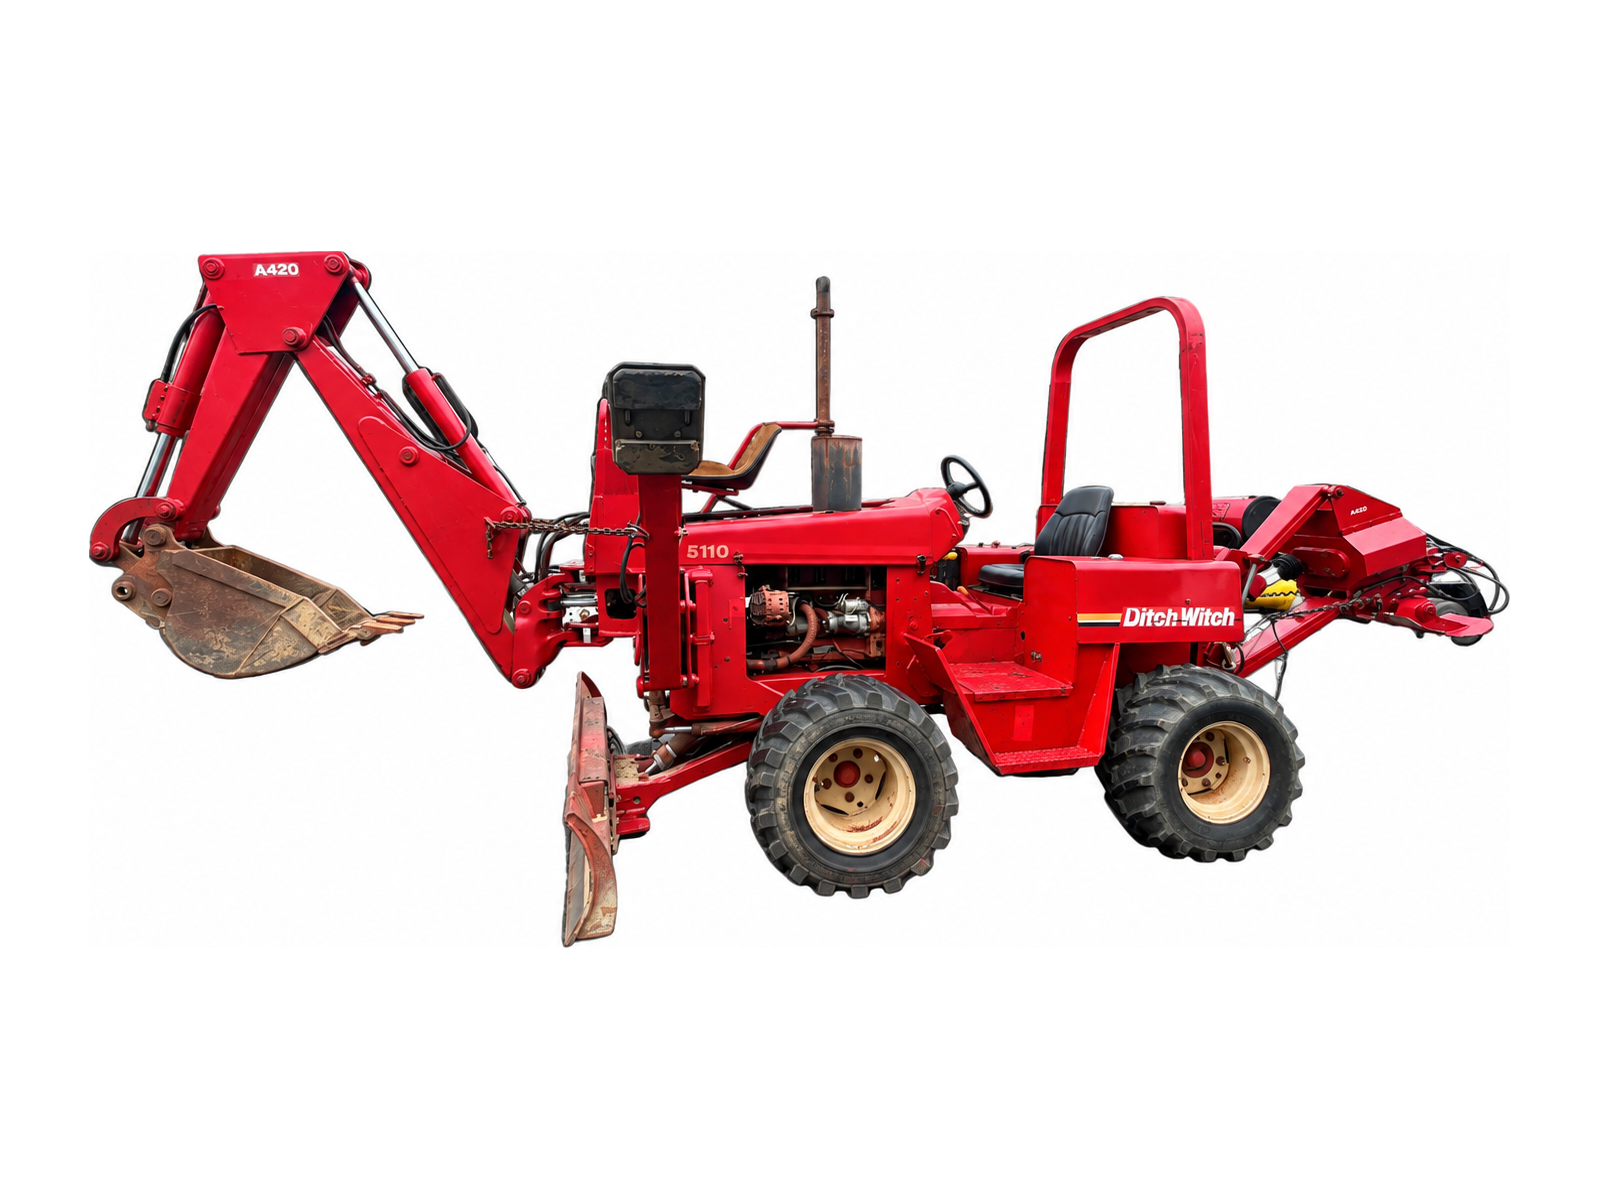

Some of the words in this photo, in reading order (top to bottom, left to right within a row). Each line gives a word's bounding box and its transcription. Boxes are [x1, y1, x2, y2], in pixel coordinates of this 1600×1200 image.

[254, 263, 299, 276] A420
[686, 544, 729, 559] 5110
[1123, 607, 1178, 627] Ditch
[1181, 607, 1235, 627] Witch
